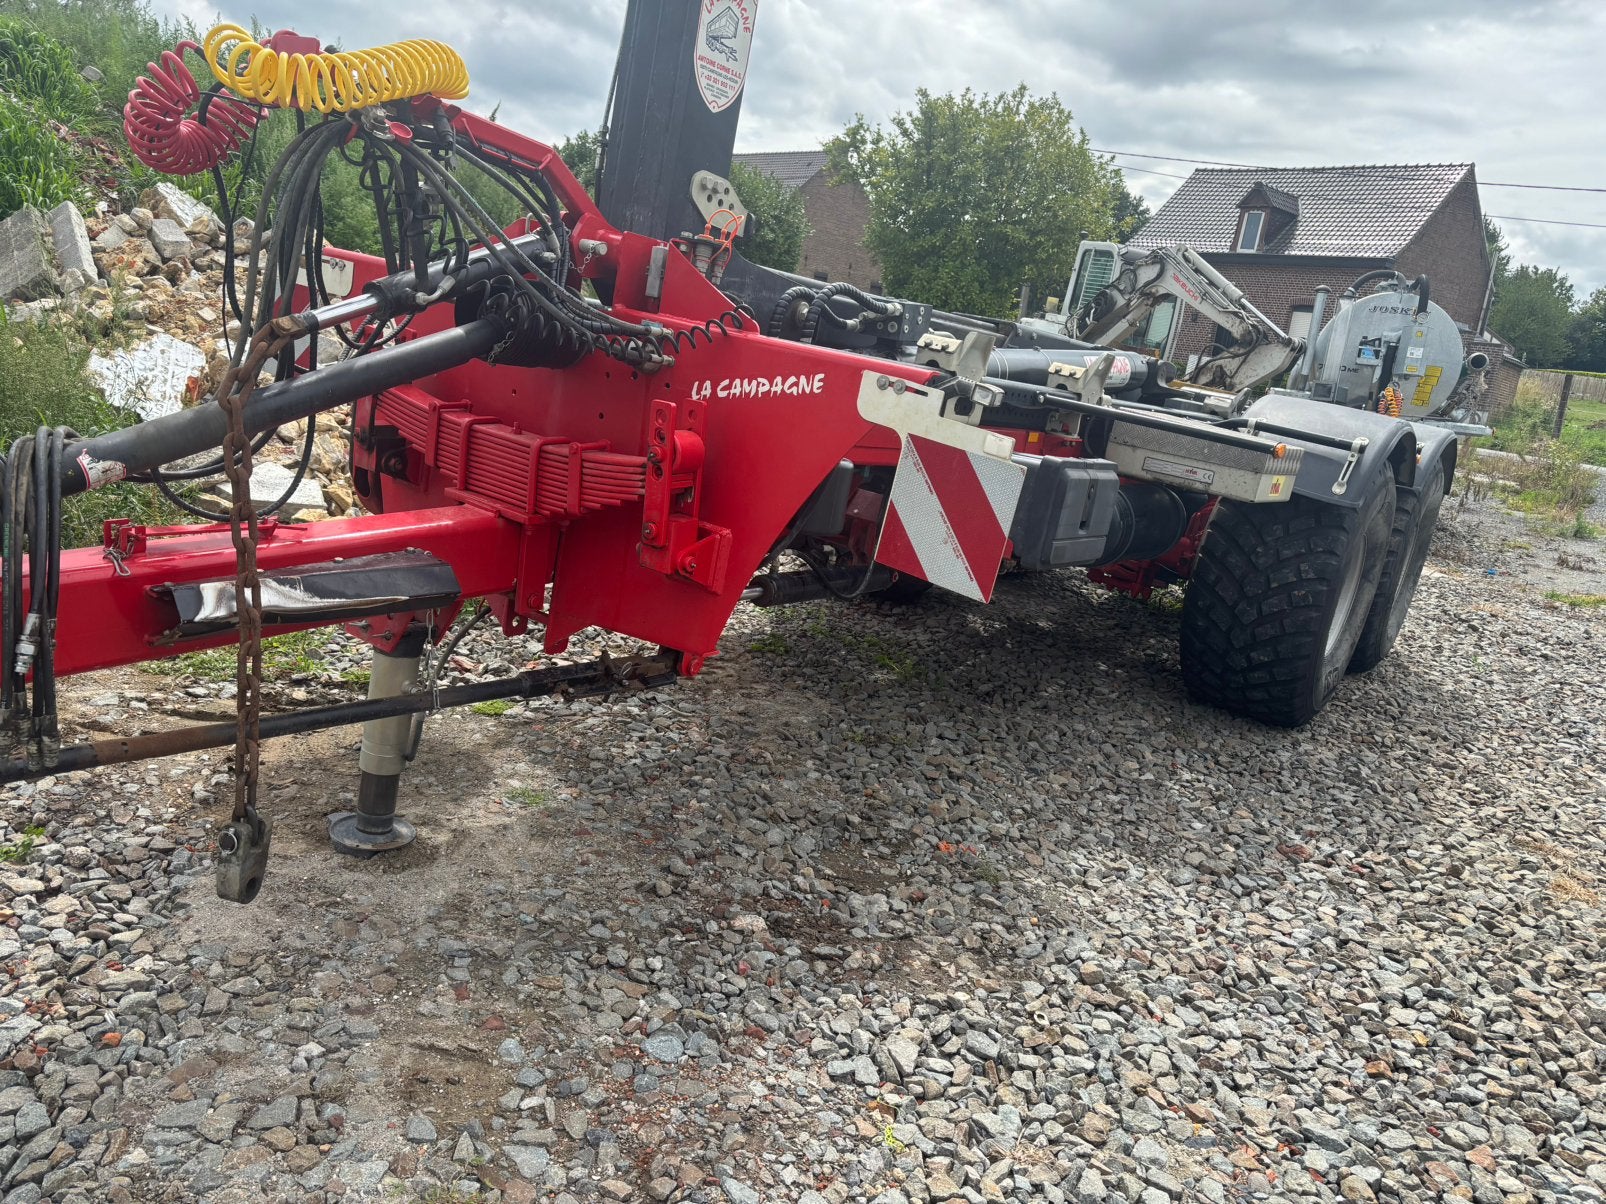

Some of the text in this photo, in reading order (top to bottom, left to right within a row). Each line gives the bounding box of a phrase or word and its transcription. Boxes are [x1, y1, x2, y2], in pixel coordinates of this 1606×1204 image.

[1368, 305, 1432, 320] JOSK
[691, 373, 825, 400] LA CAMPAGNE
